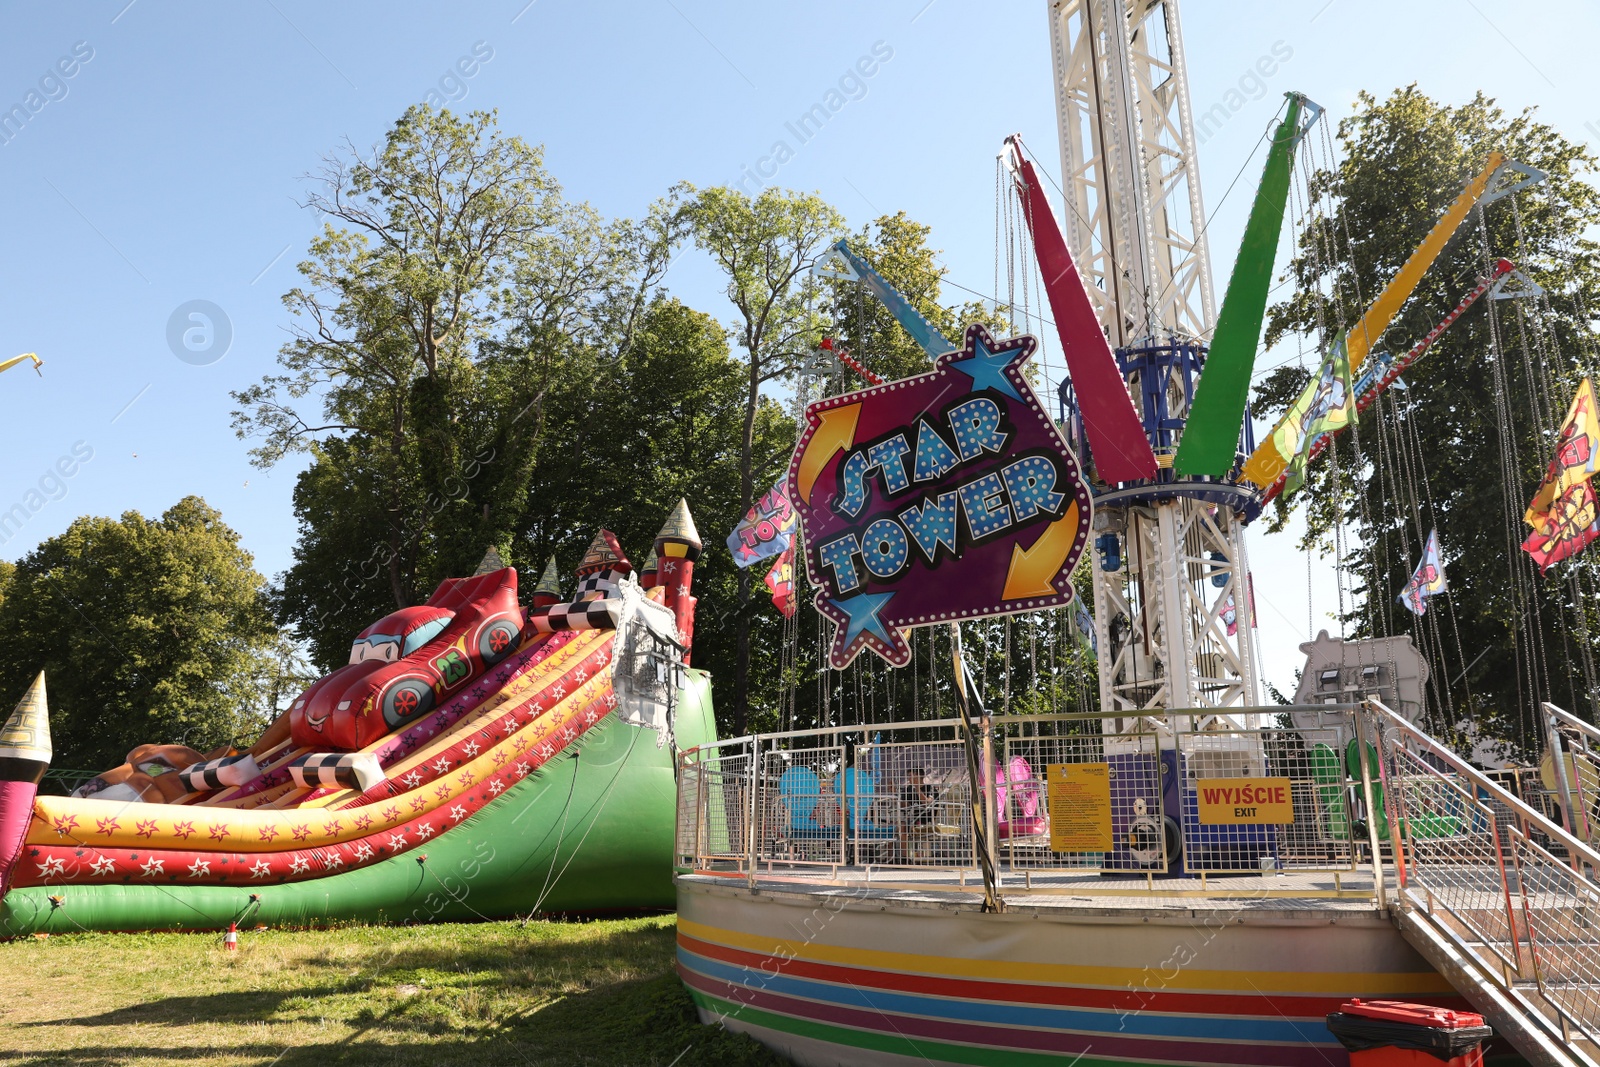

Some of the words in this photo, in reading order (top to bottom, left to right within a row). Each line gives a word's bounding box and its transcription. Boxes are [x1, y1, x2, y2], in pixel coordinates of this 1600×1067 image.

[839, 398, 1008, 518] STAR
[820, 455, 1066, 594] TOWER
[436, 651, 467, 684] 25
[1203, 784, 1286, 805] WYJŚCIE
[1234, 807, 1257, 817] EXIT
